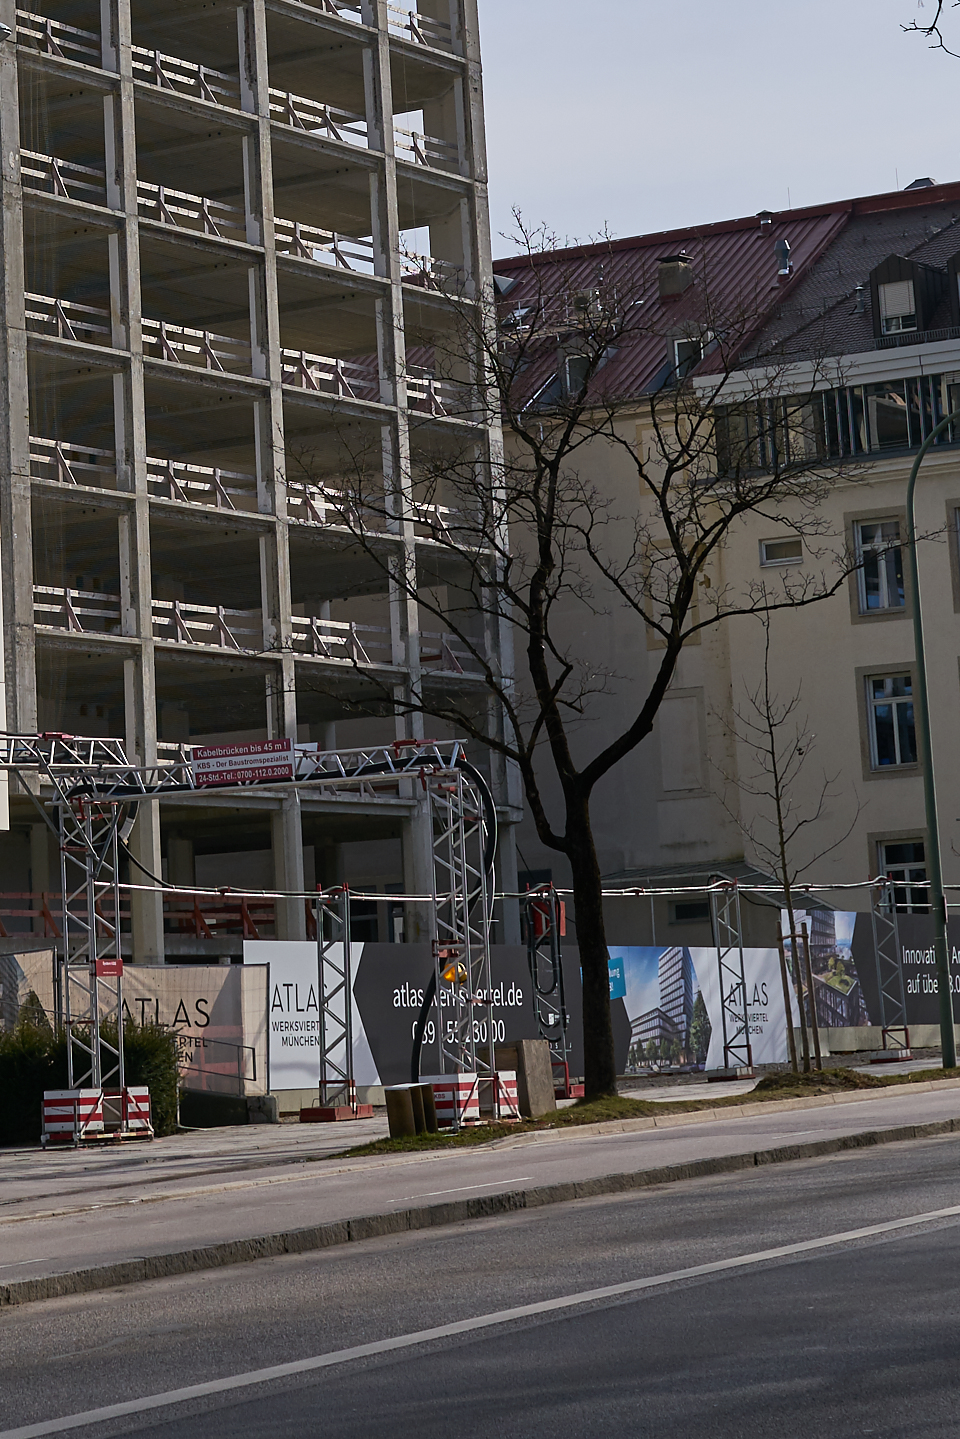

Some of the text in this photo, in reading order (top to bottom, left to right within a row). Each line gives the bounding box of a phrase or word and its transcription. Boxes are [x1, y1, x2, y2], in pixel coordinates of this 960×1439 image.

[197, 746, 249, 758] Kabelbrücken
[250, 744, 262, 752] bis
[263, 742, 273, 751] 45
[196, 762, 211, 770] KBS
[216, 760, 228, 768] Der
[228, 755, 289, 767] Baustromspezialist
[902, 944, 937, 964] Innovati
[907, 973, 920, 994] auf
[922, 973, 939, 994] übe
[271, 1020, 329, 1032] WERKSVIERTL
[735, 1023, 764, 1035] MÜCHEN
[281, 1033, 320, 1047] MÜNCHEN
